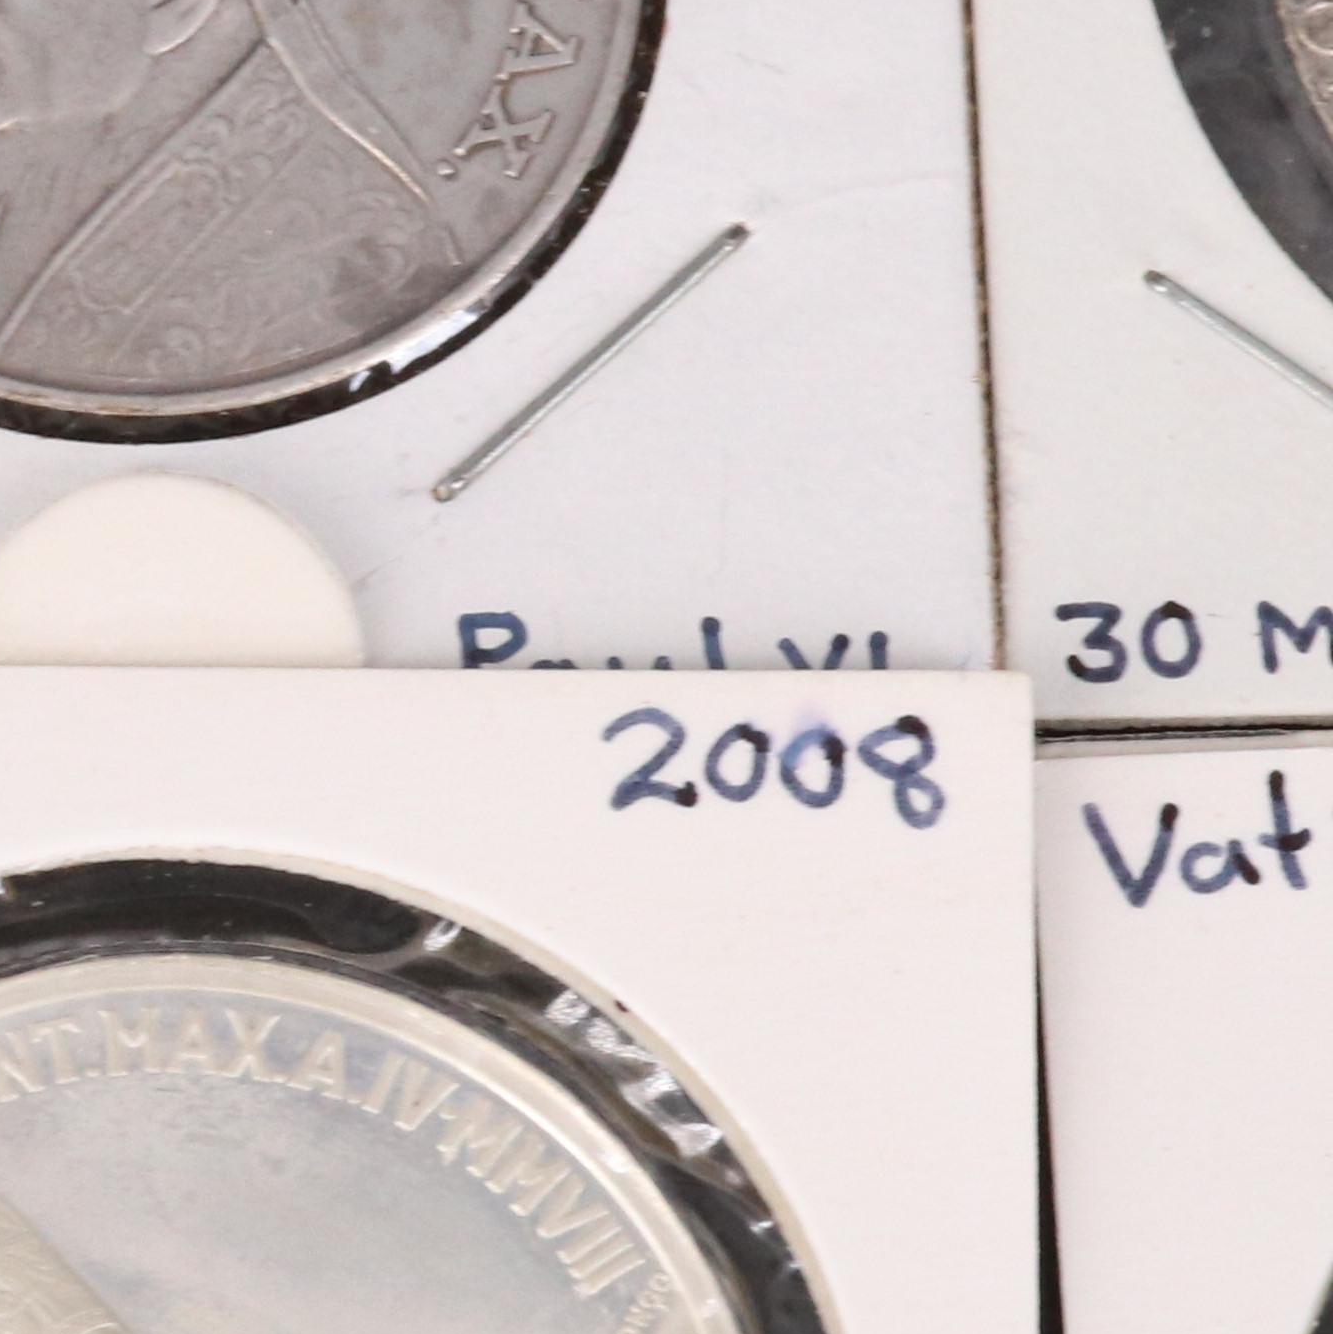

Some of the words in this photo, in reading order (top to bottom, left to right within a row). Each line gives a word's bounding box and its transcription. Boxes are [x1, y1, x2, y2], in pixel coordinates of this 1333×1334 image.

[1054, 600, 1203, 684] 30
[603, 708, 945, 829] 2008
[1082, 770, 1312, 908] Vat
